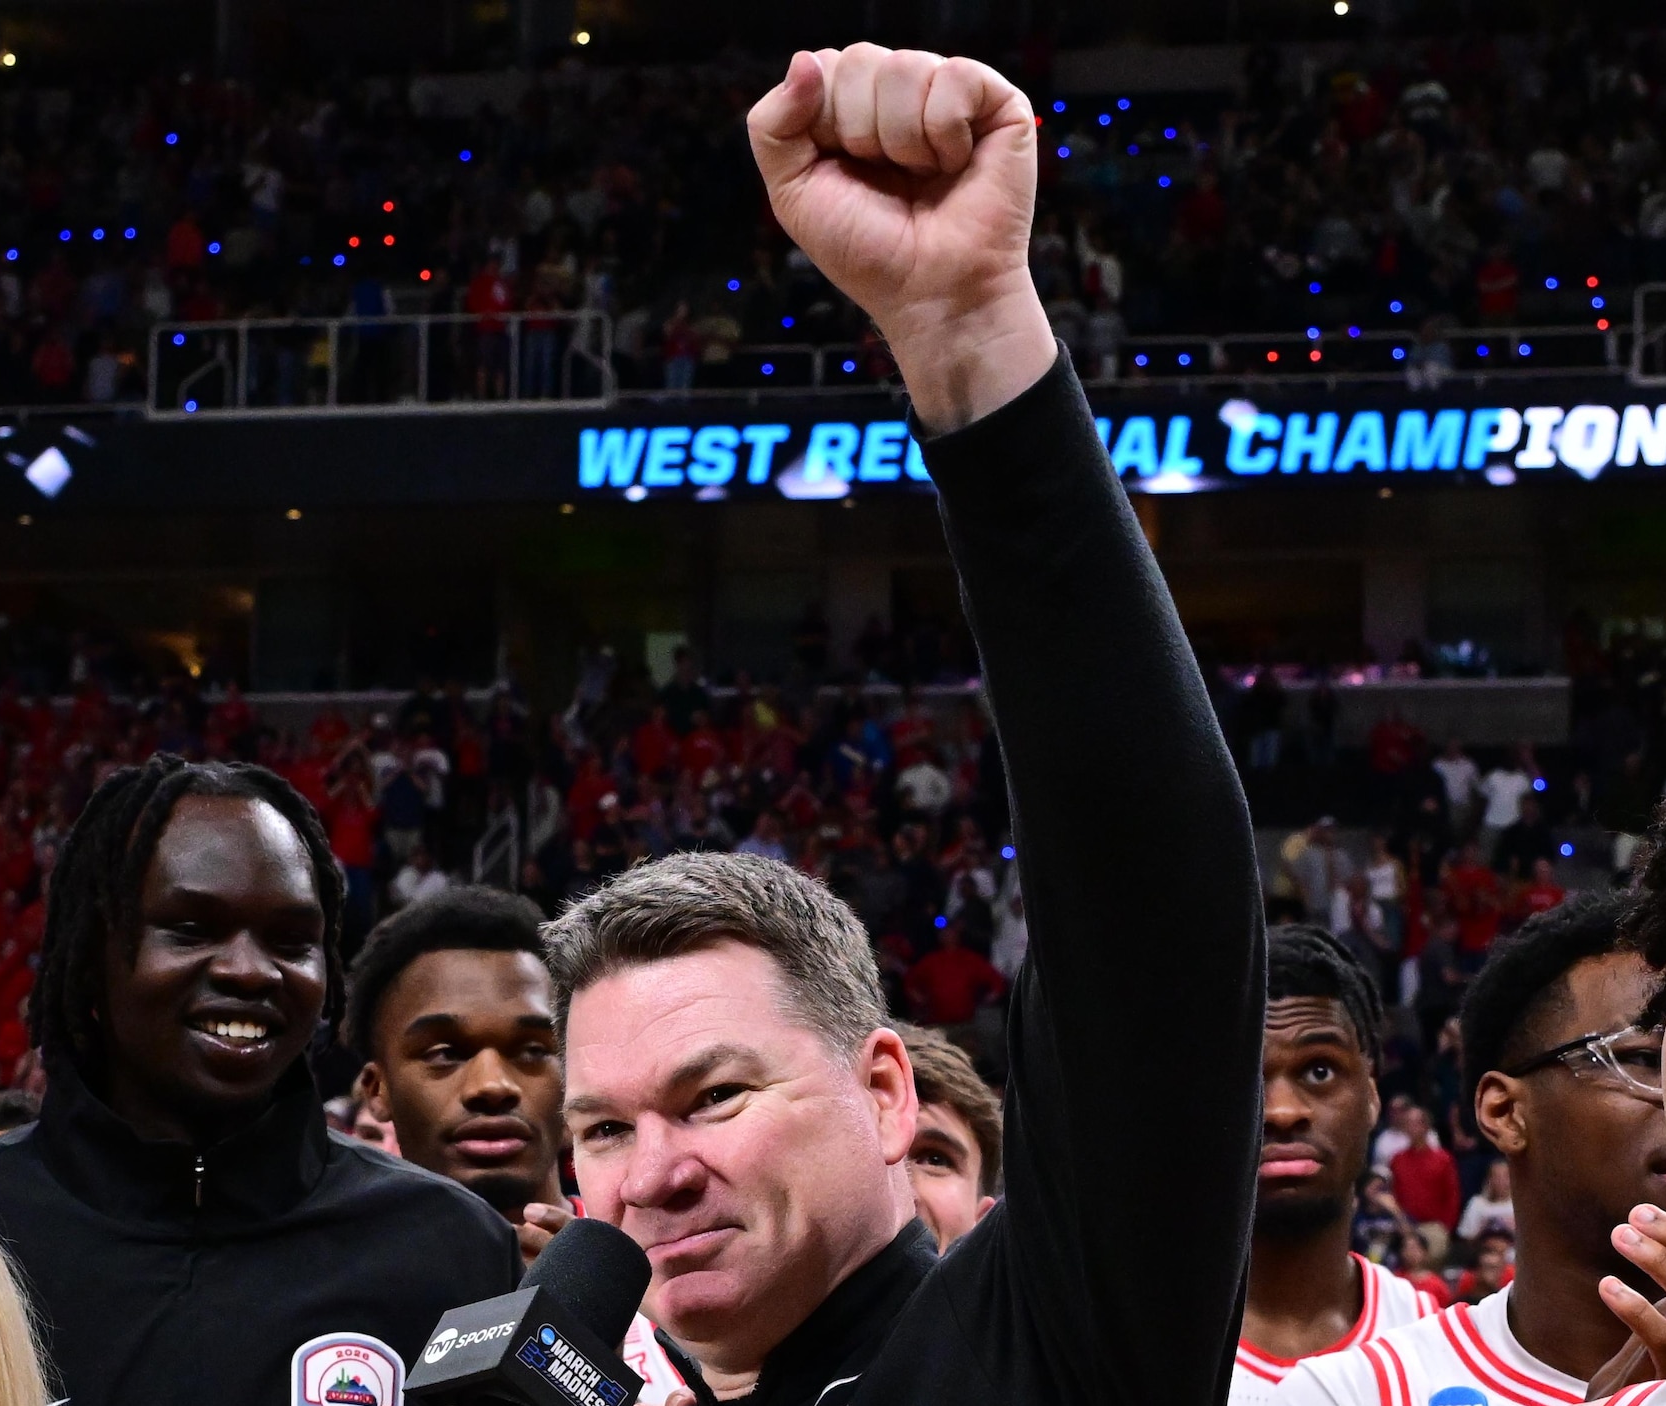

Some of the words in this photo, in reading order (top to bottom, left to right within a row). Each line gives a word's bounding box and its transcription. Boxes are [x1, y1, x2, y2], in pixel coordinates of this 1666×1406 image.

[579, 424, 789, 488] WEST
[802, 414, 1204, 483] REAL
[455, 1321, 516, 1348] SPORTS
[550, 1338, 602, 1389] MARCH
